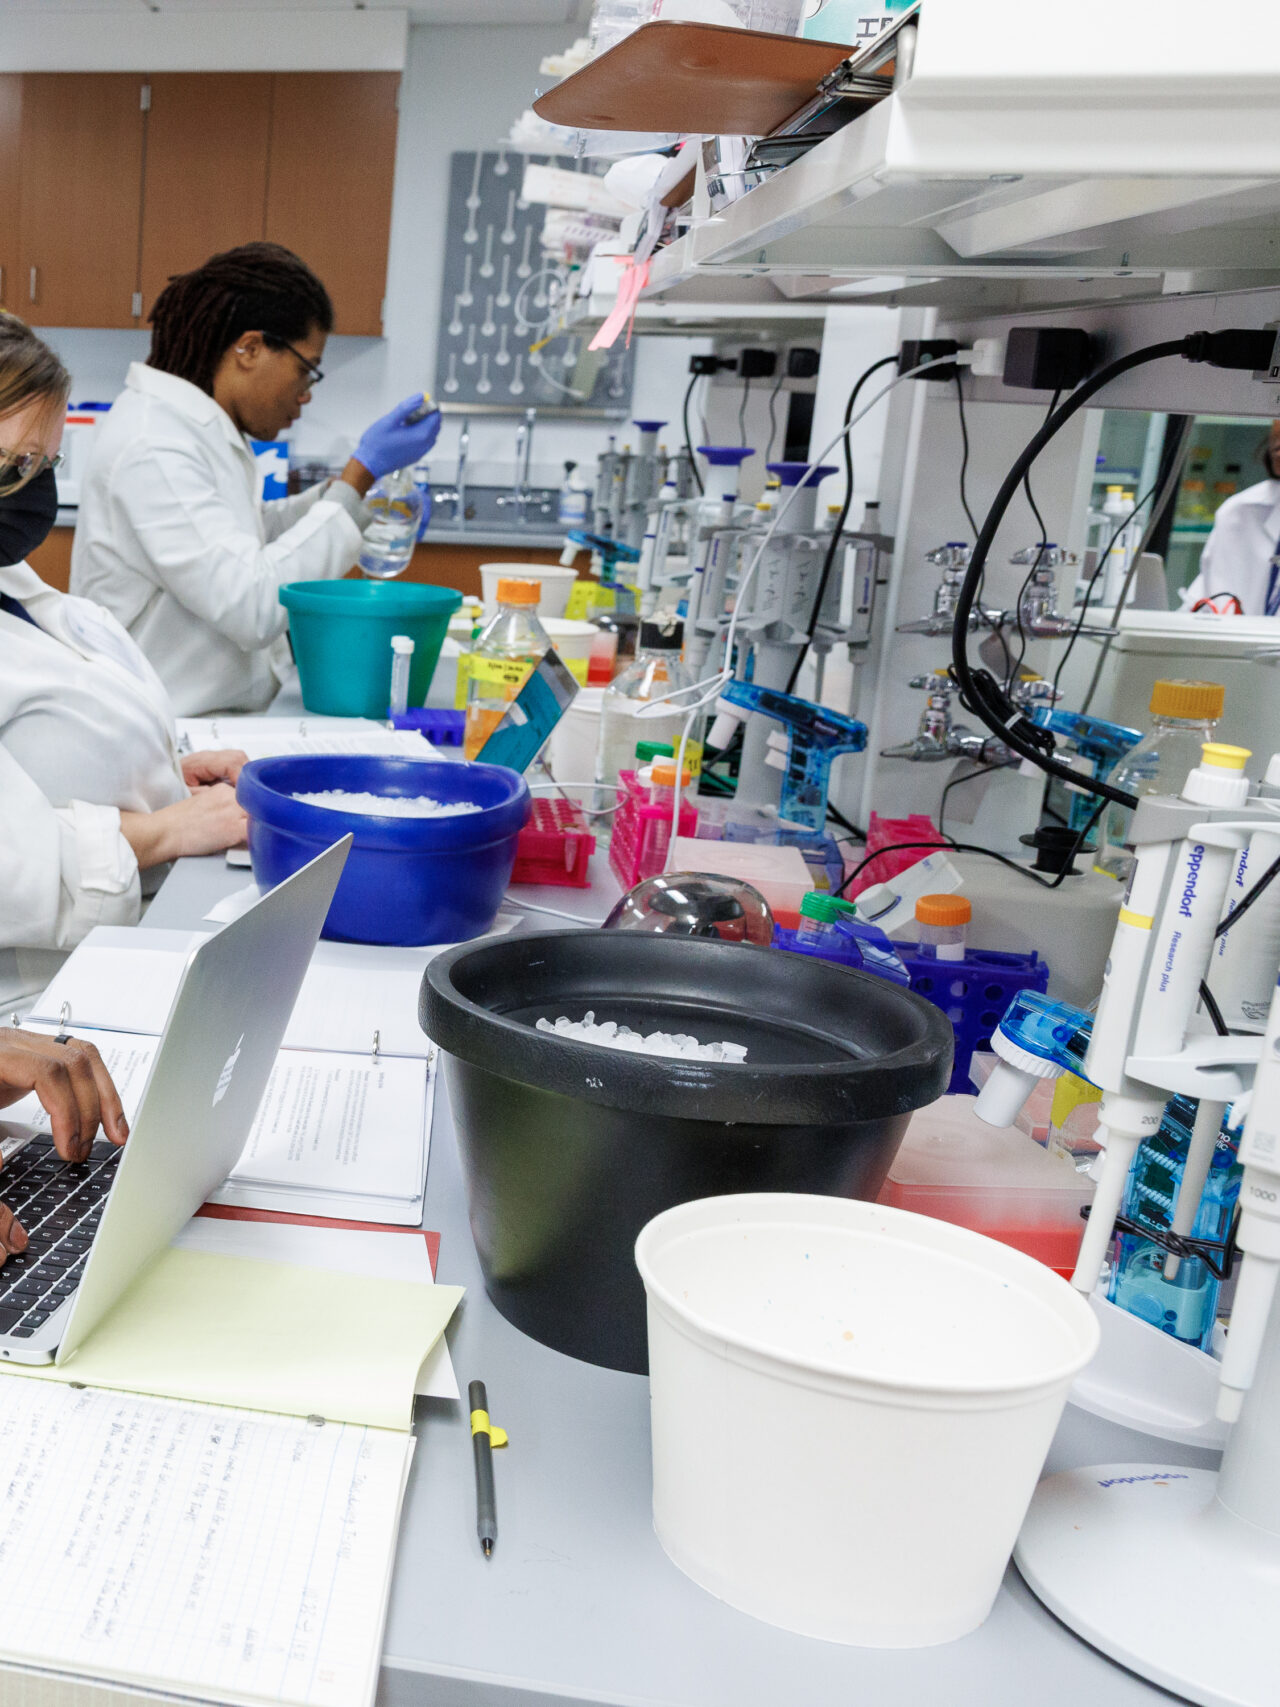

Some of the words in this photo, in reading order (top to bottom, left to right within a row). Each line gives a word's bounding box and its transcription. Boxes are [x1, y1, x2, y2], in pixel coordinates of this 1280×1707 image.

[1235, 848, 1250, 888] ndorf
[1178, 844, 1205, 918] eppendorf
[1164, 930, 1182, 973] Research
[1159, 972, 1171, 993] plus
[1141, 1115, 1159, 1125] 200
[1249, 1186, 1278, 1203] 1000
[1097, 1473, 1189, 1488] eppendorf
